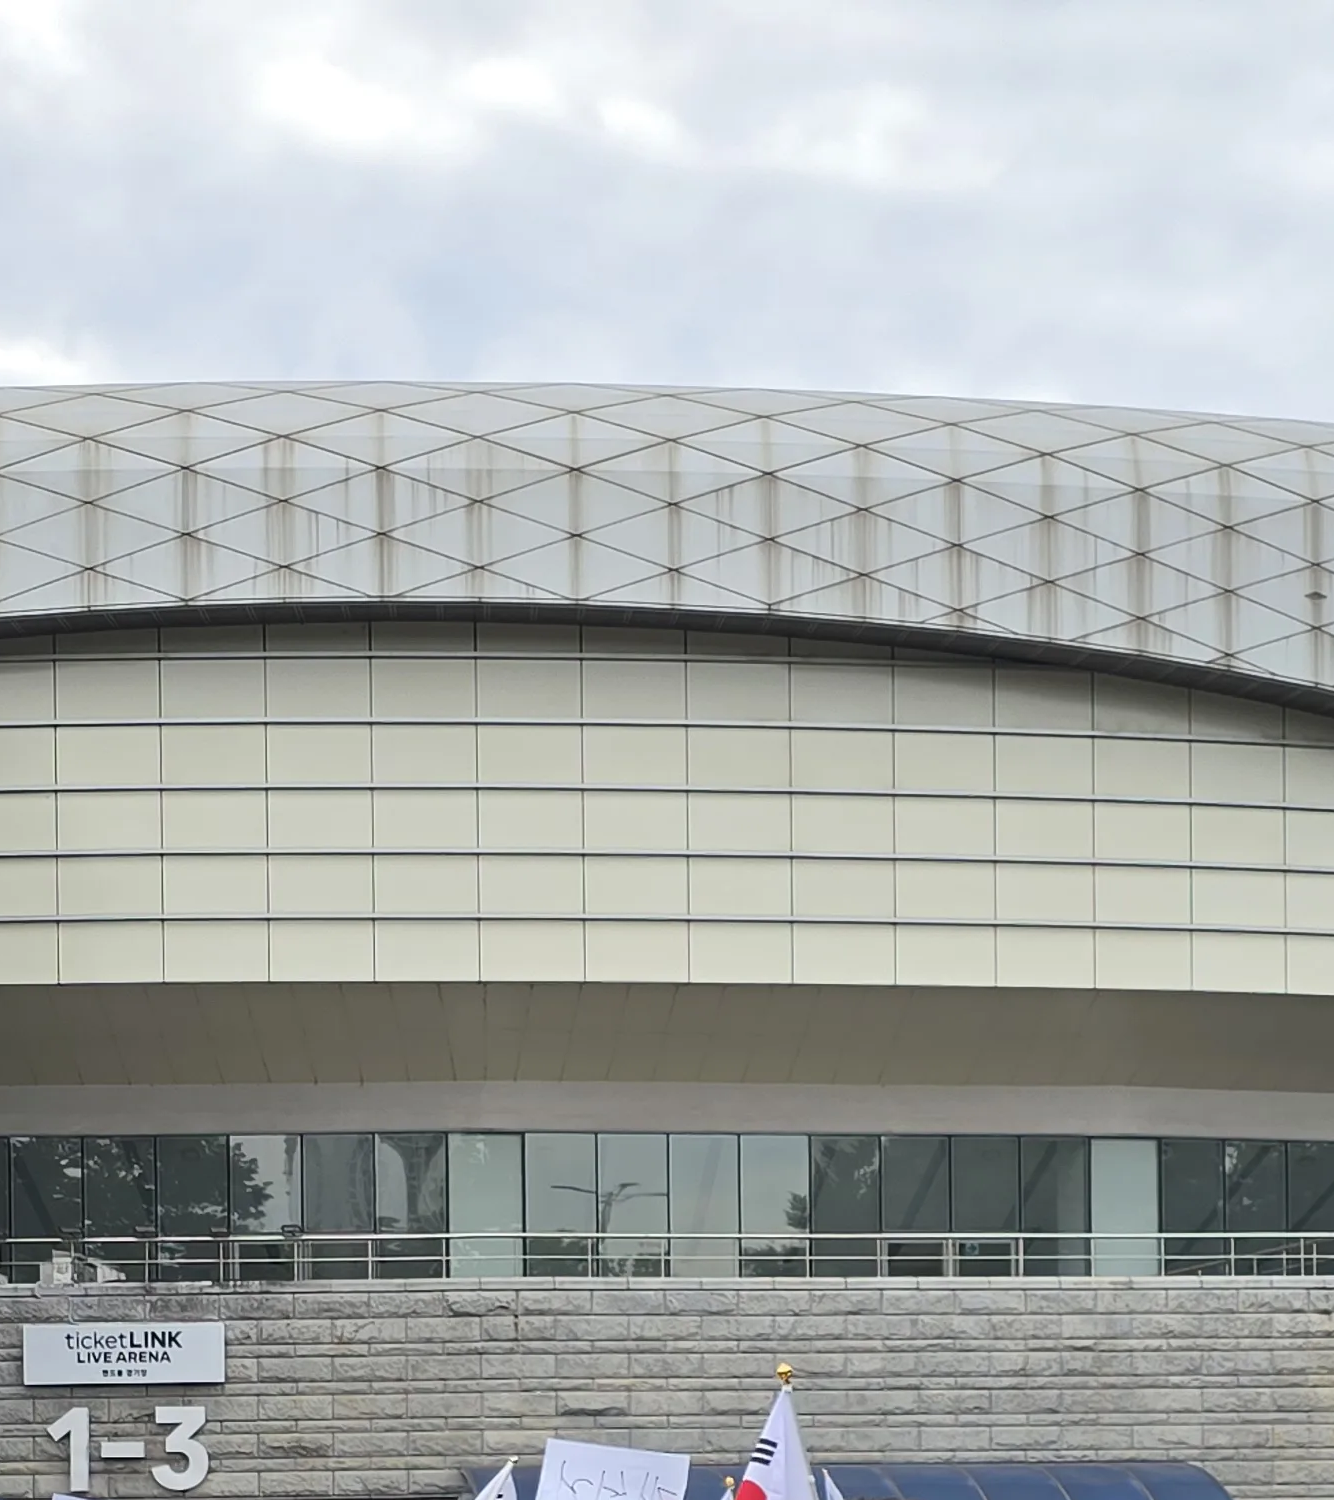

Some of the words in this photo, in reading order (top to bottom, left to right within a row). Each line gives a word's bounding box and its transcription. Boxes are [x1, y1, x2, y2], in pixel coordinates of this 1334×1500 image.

[64, 1330, 183, 1350] ticketLINK
[76, 1351, 113, 1364] LIVE
[116, 1351, 172, 1364] ARENA
[46, 1406, 210, 1493] 1-3
